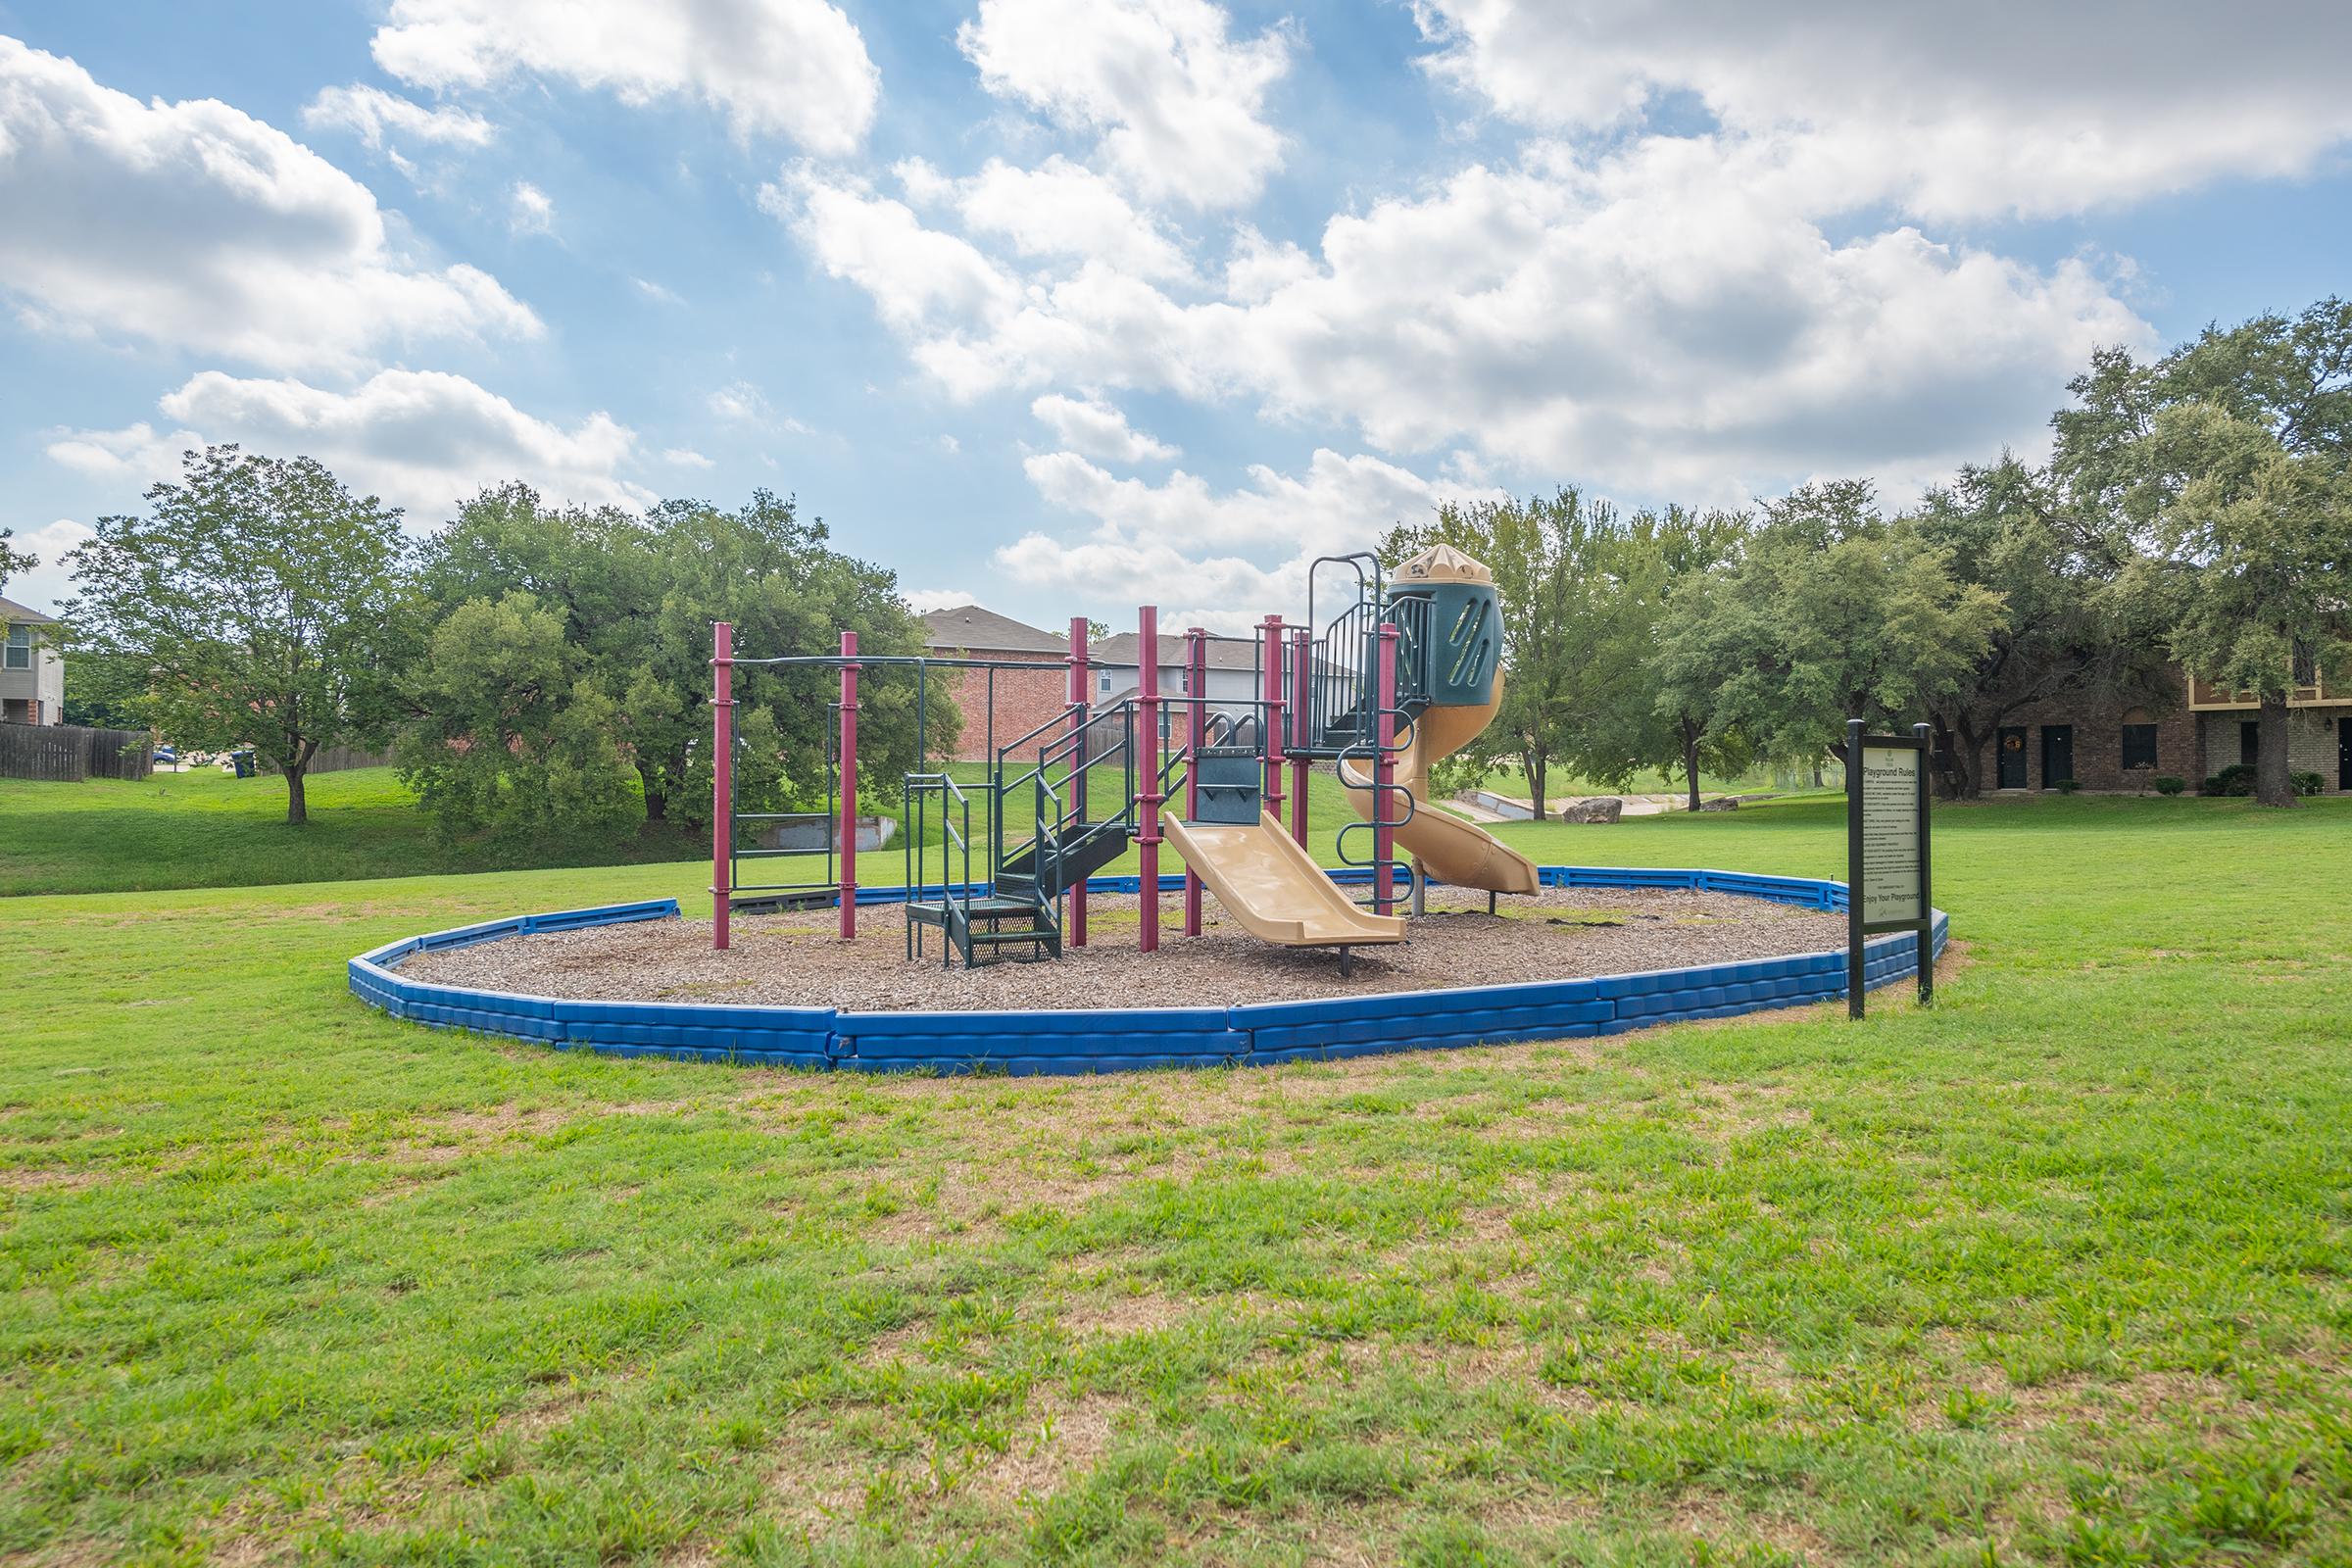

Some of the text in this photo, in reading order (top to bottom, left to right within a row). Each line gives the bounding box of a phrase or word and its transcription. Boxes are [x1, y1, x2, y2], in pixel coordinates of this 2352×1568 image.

[1863, 767, 1916, 778] Playground Rules
[1863, 894, 1877, 905] Enjoy
[1878, 893, 1889, 902] Your
